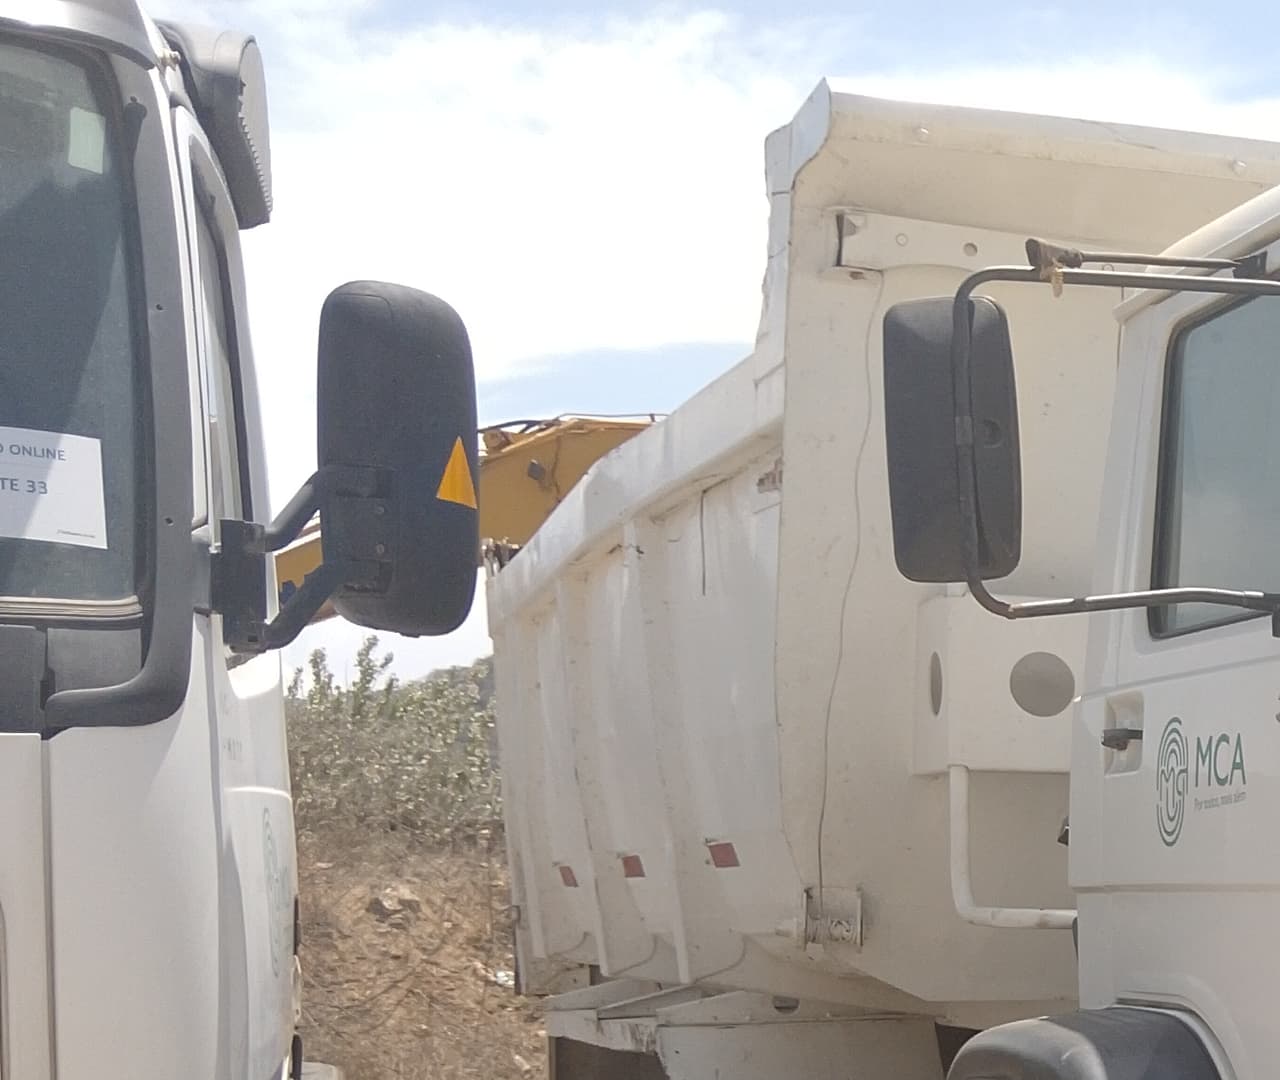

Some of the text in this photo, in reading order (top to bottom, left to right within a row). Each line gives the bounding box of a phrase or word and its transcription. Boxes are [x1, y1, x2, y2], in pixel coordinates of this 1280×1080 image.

[9, 444, 66, 461] ONLINE
[26, 480, 48, 495] 33
[1195, 732, 1247, 788] MCA
